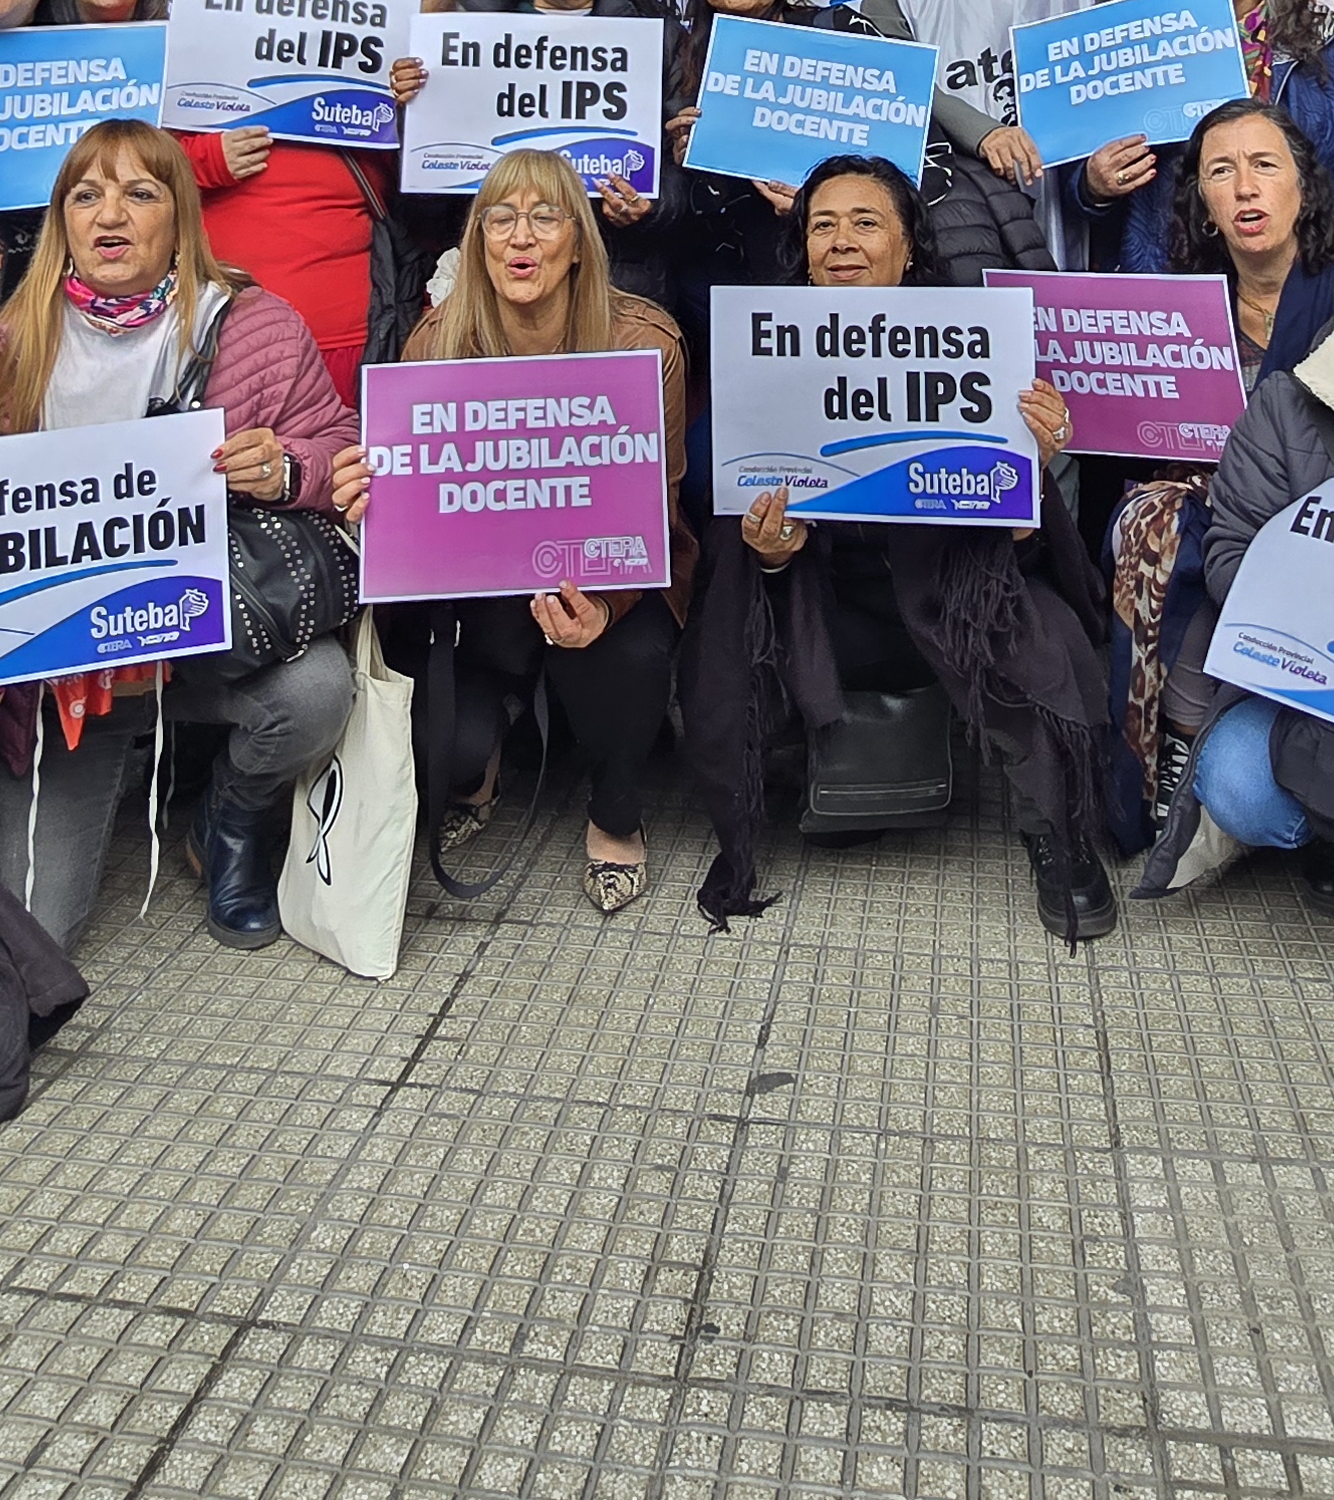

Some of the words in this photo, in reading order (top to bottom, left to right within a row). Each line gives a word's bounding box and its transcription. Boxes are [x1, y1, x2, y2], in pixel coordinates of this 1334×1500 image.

[255, 28, 307, 66] del
[317, 30, 385, 74] IPS
[441, 31, 481, 68] En
[493, 32, 628, 73] defensa
[1047, 40, 1081, 63] EN
[1083, 9, 1198, 54] DEFENSA
[743, 48, 780, 75] EN
[782, 55, 897, 94] DEFENSA
[1020, 73, 1051, 93] DE
[1055, 64, 1086, 86] LA
[1087, 26, 1236, 76] JUBILACIÓN
[496, 82, 550, 119] del
[561, 80, 628, 122] IPS
[706, 71, 742, 96] DE
[744, 77, 777, 104] LA
[776, 84, 927, 128] JUBILACIÓN
[1069, 63, 1186, 106] DOCENTE
[312, 96, 373, 127] Suteba
[752, 106, 870, 147] DOCENTE
[751, 312, 800, 357] En
[816, 313, 991, 359] defensa
[1061, 308, 1192, 337] DEFENSA
[1035, 338, 1069, 364] LA
[1069, 338, 1235, 371] JUBILACIÓN
[825, 376, 892, 422] del
[906, 371, 993, 423] IPS
[1051, 369, 1180, 400] DOCENTE
[412, 402, 457, 435] EN
[464, 395, 617, 432] DEFENSA
[368, 445, 413, 477] DE
[419, 442, 463, 475] LA
[464, 425, 659, 473] JUBILACIÓN
[114, 462, 158, 500] de
[438, 476, 592, 514] DOCENTE
[908, 462, 990, 496] Suteba
[584, 536, 648, 559] CTERA
[90, 602, 179, 640] Suteba
